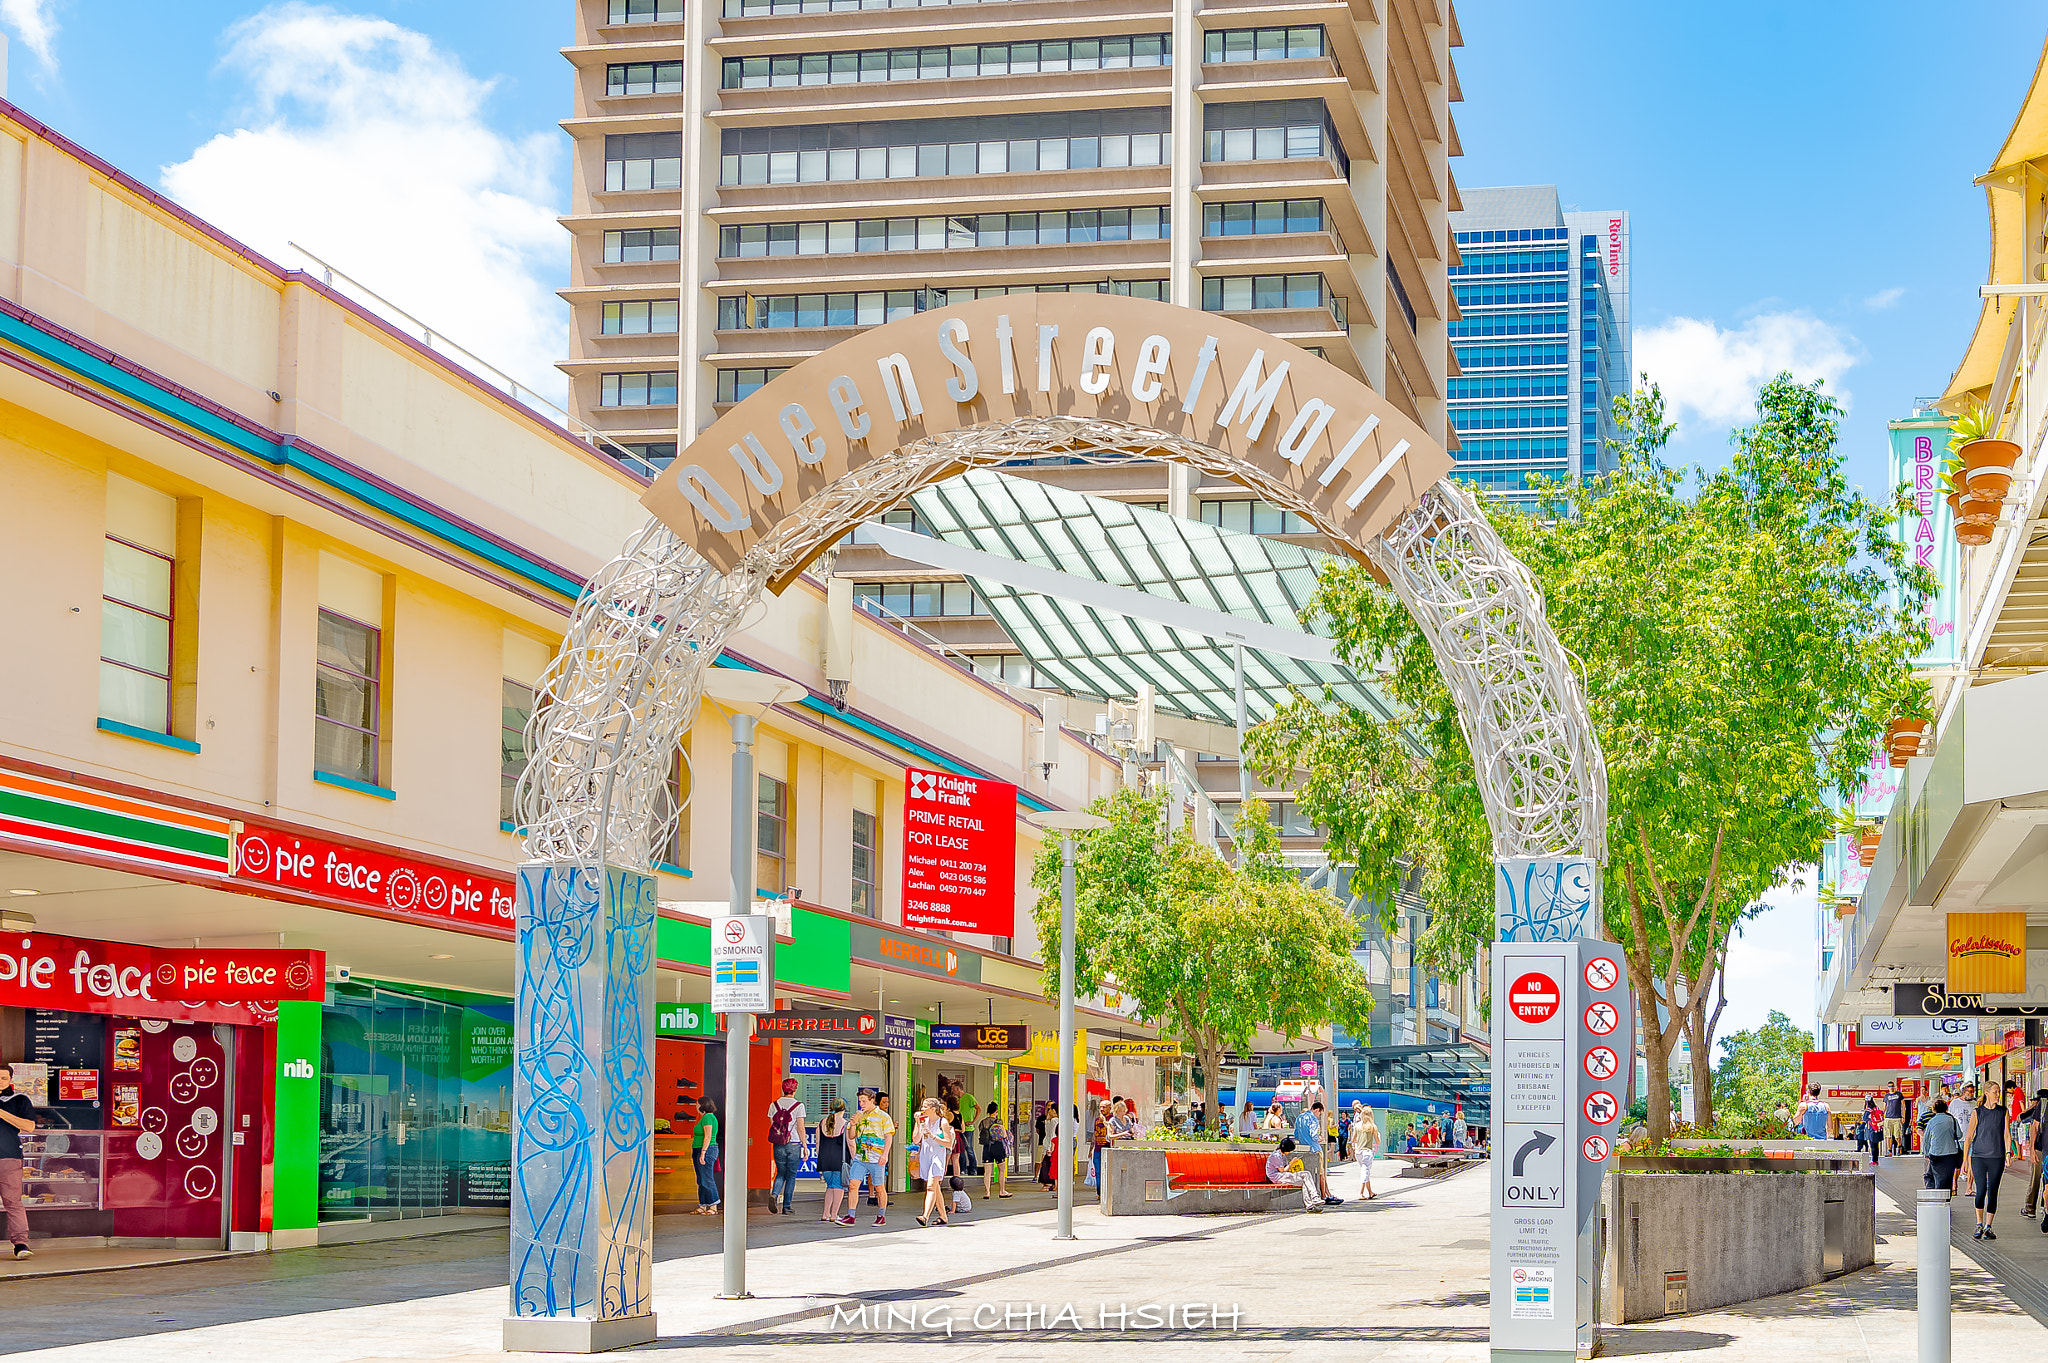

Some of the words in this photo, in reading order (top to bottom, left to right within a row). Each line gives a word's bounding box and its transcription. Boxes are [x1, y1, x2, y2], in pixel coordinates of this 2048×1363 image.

[677, 351, 924, 533] Queen
[938, 314, 1218, 414] Street
[1216, 348, 1411, 510] Mall
[1915, 437, 1935, 600] BREAK
[938, 776, 977, 795] Knight
[938, 790, 971, 807] Frank
[909, 809, 946, 826] PRIME
[948, 815, 985, 832] RETAIL
[908, 831, 932, 846] FOR
[935, 834, 969, 850] LEASE
[275, 841, 315, 881] pie
[324, 852, 381, 893] face
[908, 854, 937, 866] Michael
[940, 859, 957, 868] 0411
[959, 861, 972, 870] 200
[974, 863, 986, 872] 734
[908, 868, 924, 877] Alex
[940, 871, 957, 881] 0423
[959, 873, 971, 883] 045
[973, 875, 986, 885] 586
[908, 880, 935, 891] Lachlan
[940, 884, 957, 893] 0450
[959, 886, 971, 895] 770
[973, 888, 986, 897] 447
[450, 879, 483, 915] pie
[489, 887, 516, 920] fa
[907, 899, 928, 911] 3246
[930, 902, 951, 913] 8888
[907, 913, 977, 928] KnightFrank.com.au
[714, 947, 721, 955] NO
[723, 946, 763, 955] SMOKING
[880, 936, 944, 969] MERRELL
[1950, 935, 2021, 957] Gelatissimo
[184, 959, 217, 989] pie
[224, 961, 277, 985] face
[1527, 981, 1541, 991] NO
[660, 1008, 699, 1029] nib
[1518, 1006, 1550, 1015] ENTRY
[471, 1026, 487, 1036] JOIN
[488, 1026, 506, 1036] OVER
[759, 1017, 855, 1031] MERRELL
[885, 1024, 914, 1038] EXCHANGE
[1932, 1018, 1969, 1034] UGG
[477, 1036, 506, 1045] MILLION
[977, 1029, 1009, 1044] UGG
[471, 1046, 488, 1054] WHO
[489, 1046, 508, 1054] THINK
[1035, 1045, 1058, 1062] TATTO
[1129, 1044, 1144, 1053] YA
[1146, 1044, 1175, 1053] TREE
[471, 1055, 495, 1064] WORTH
[496, 1055, 504, 1064] IT
[790, 1057, 840, 1069] RRENCY
[283, 1058, 315, 1079] nib
[1374, 1075, 1385, 1084] 141
[1507, 1186, 1560, 1200] ONLY
